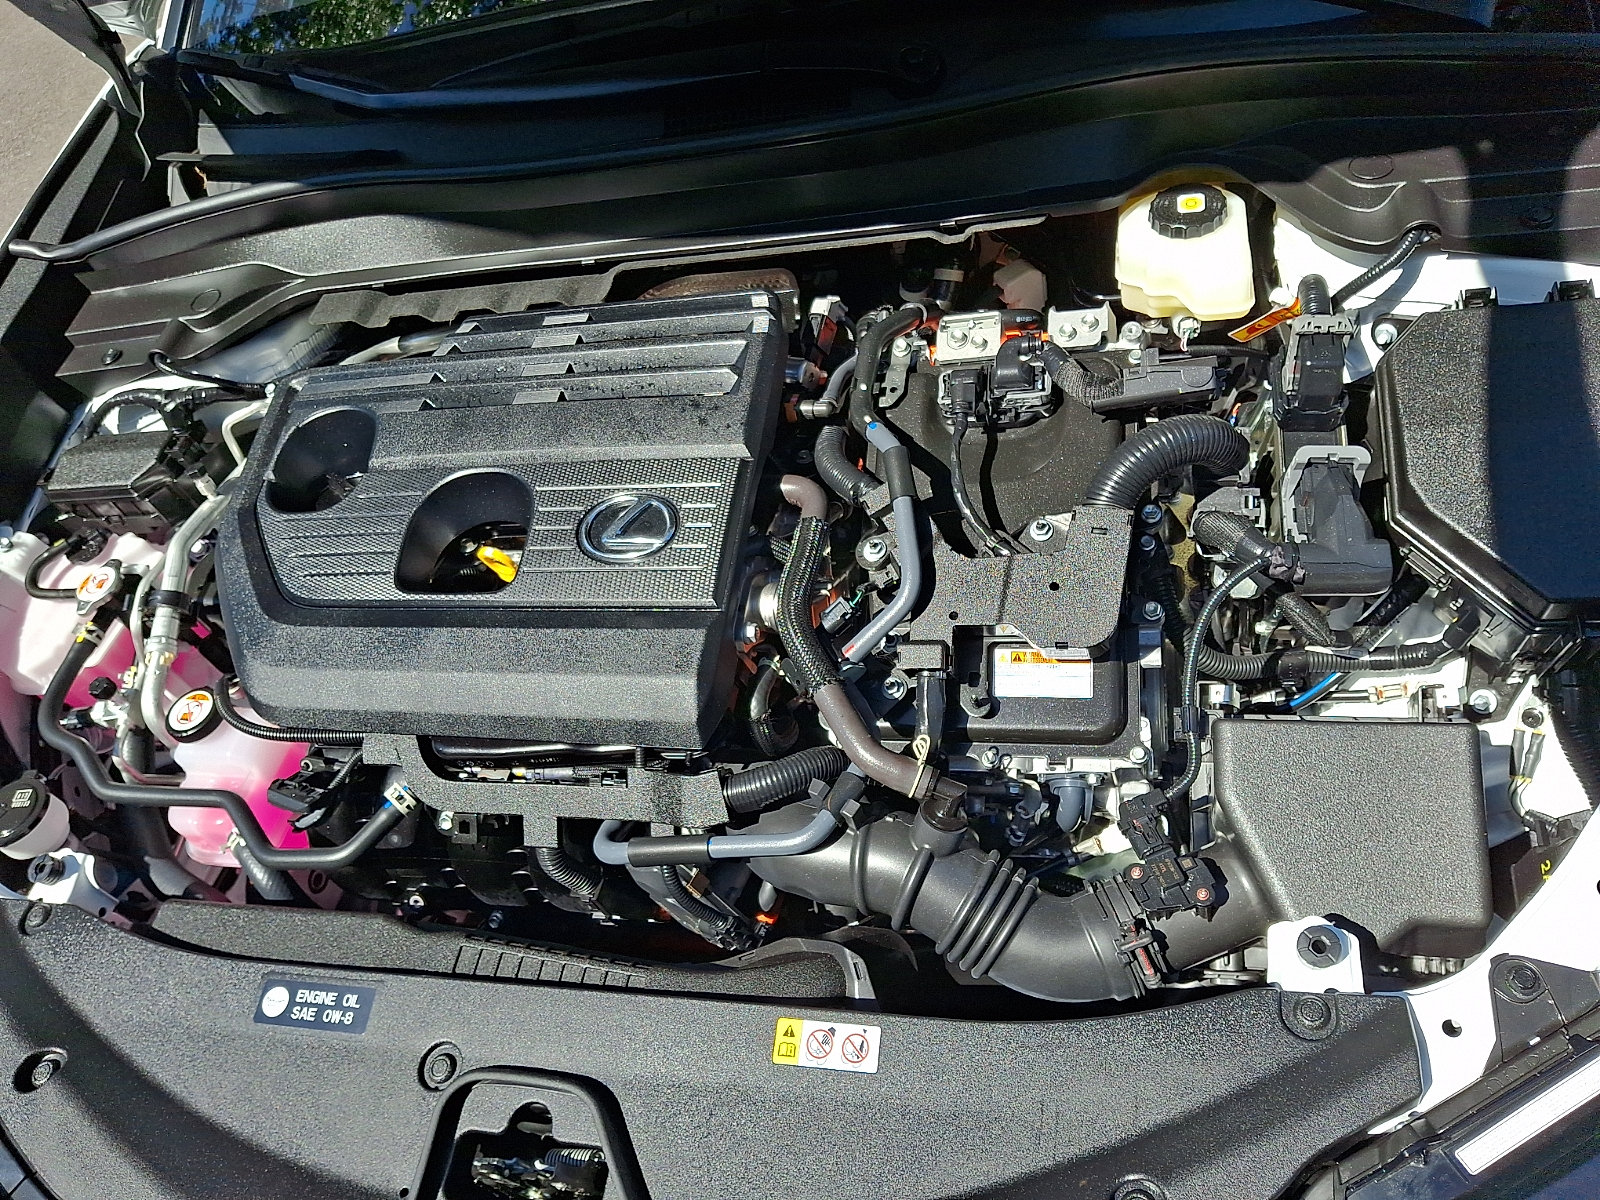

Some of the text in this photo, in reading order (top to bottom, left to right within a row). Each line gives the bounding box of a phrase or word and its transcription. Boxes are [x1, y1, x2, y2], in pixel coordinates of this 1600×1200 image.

[295, 989, 338, 1006] ENGINE
[342, 994, 361, 1009] OIL
[290, 1006, 354, 1025] SAE 0W-8
